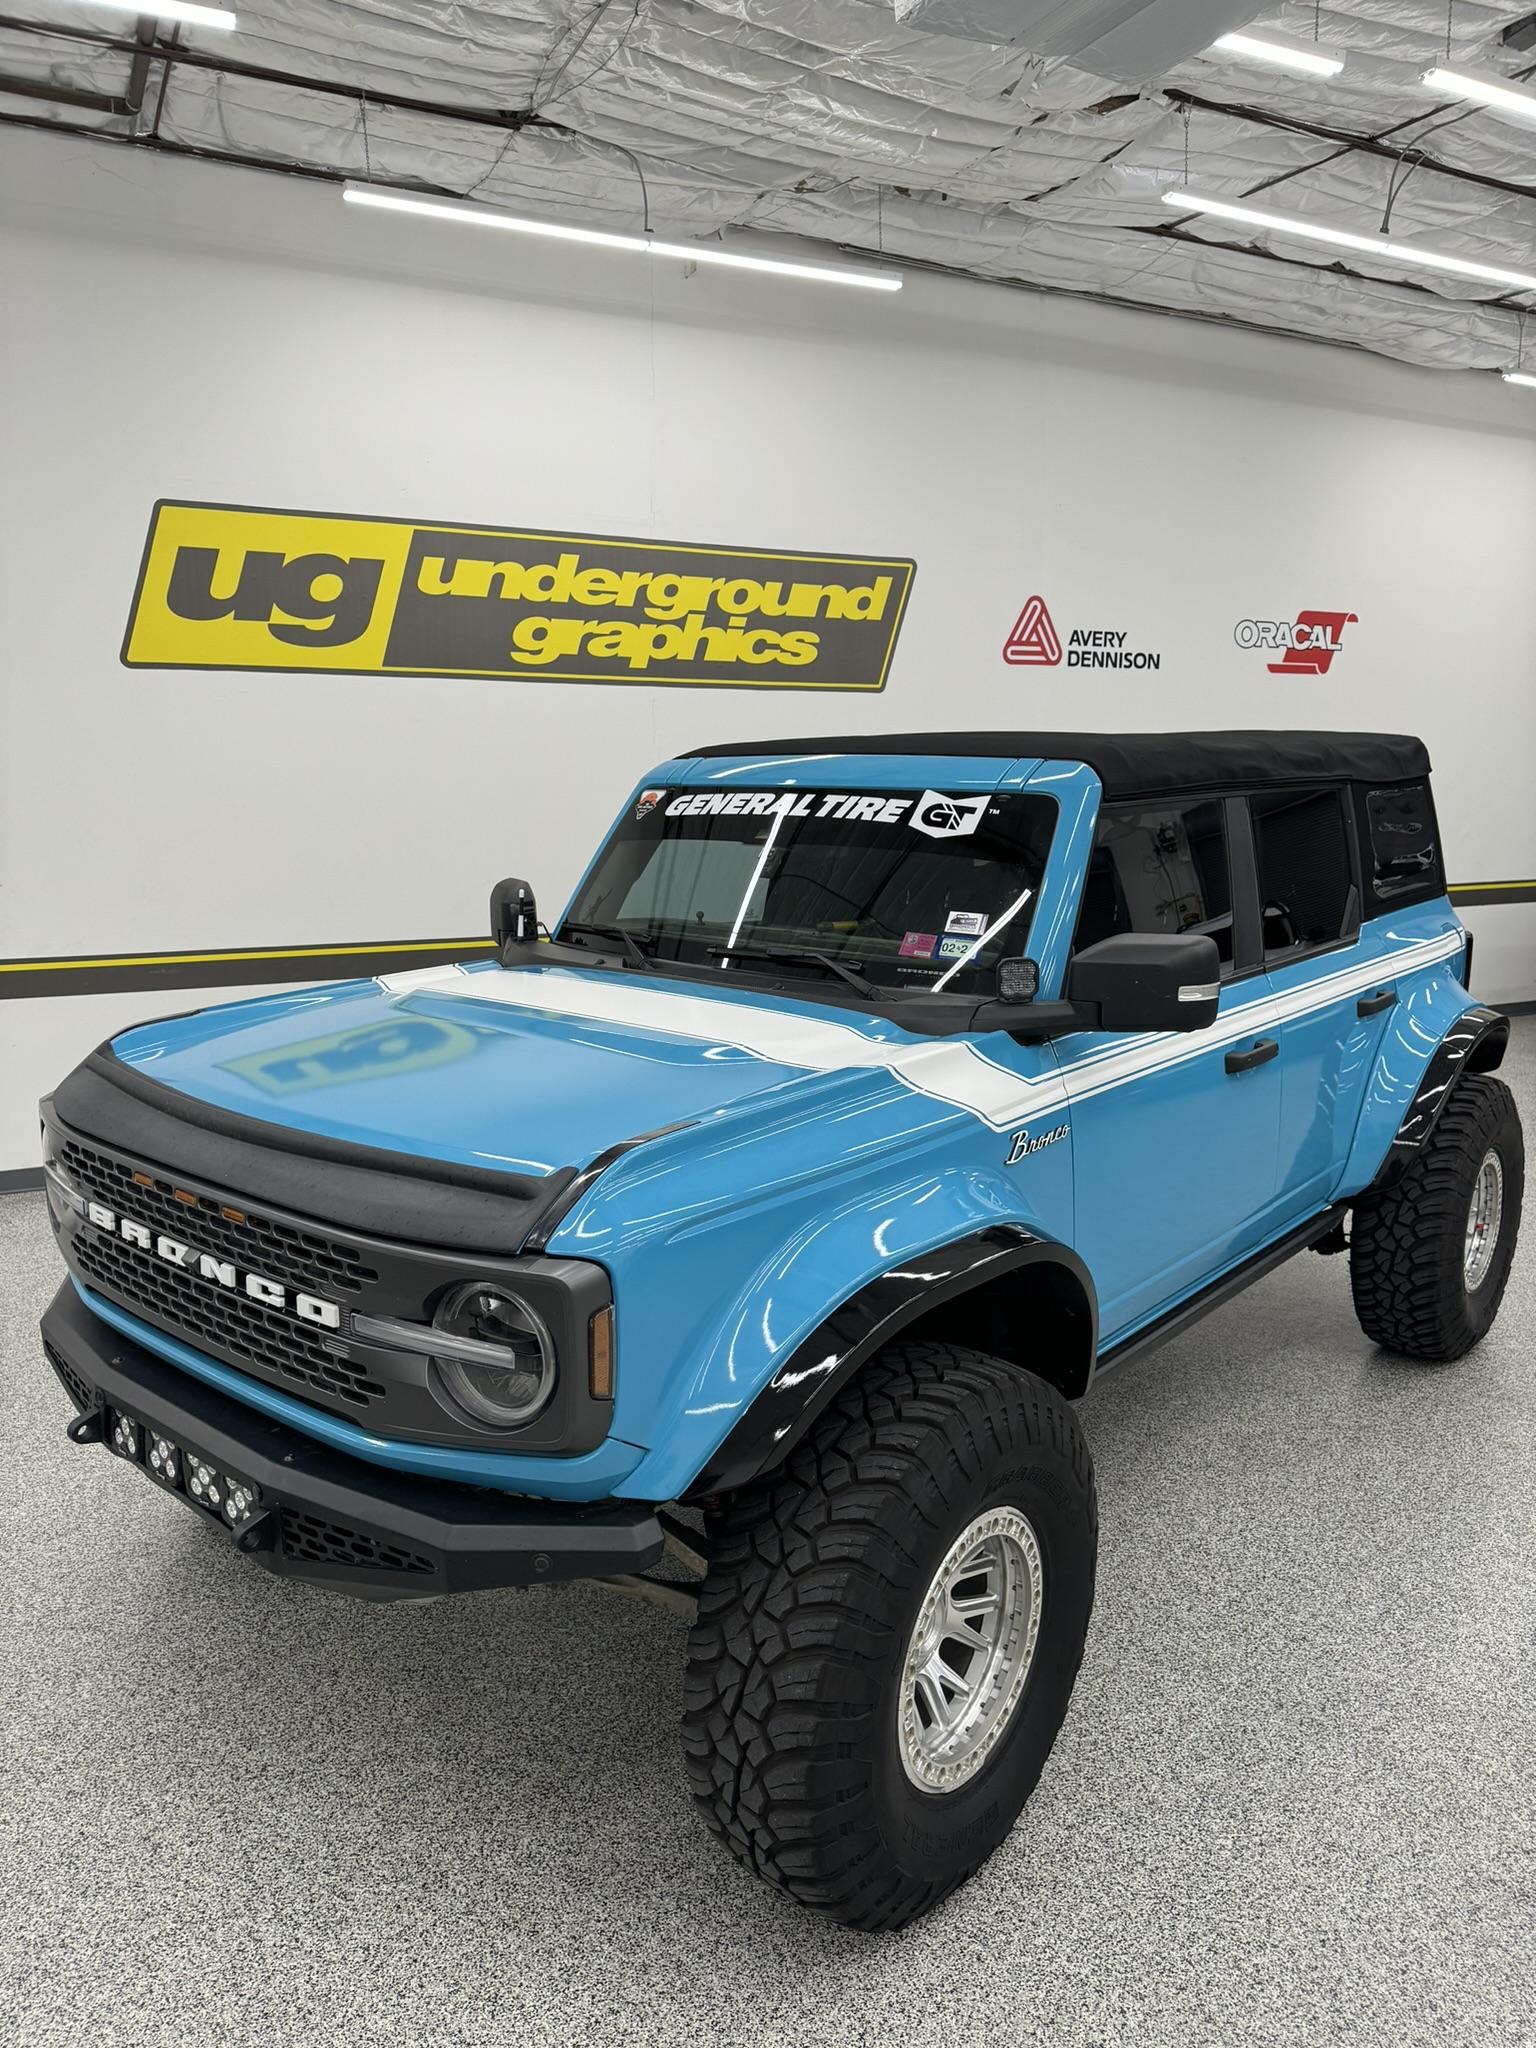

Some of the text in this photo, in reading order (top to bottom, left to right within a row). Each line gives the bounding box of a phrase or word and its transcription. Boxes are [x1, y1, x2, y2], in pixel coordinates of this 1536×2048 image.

[167, 546, 385, 648] ug
[416, 554, 892, 620] underground
[511, 614, 819, 668] graphics
[1068, 630, 1127, 648] AVERY
[1234, 620, 1343, 651] ORACAL
[1067, 650, 1160, 669] DENNISON
[665, 793, 914, 823] GENERAL TIRE
[921, 803, 978, 830] GT
[1004, 1124, 1071, 1165] Bronco
[88, 1201, 341, 1328] BRONCO
